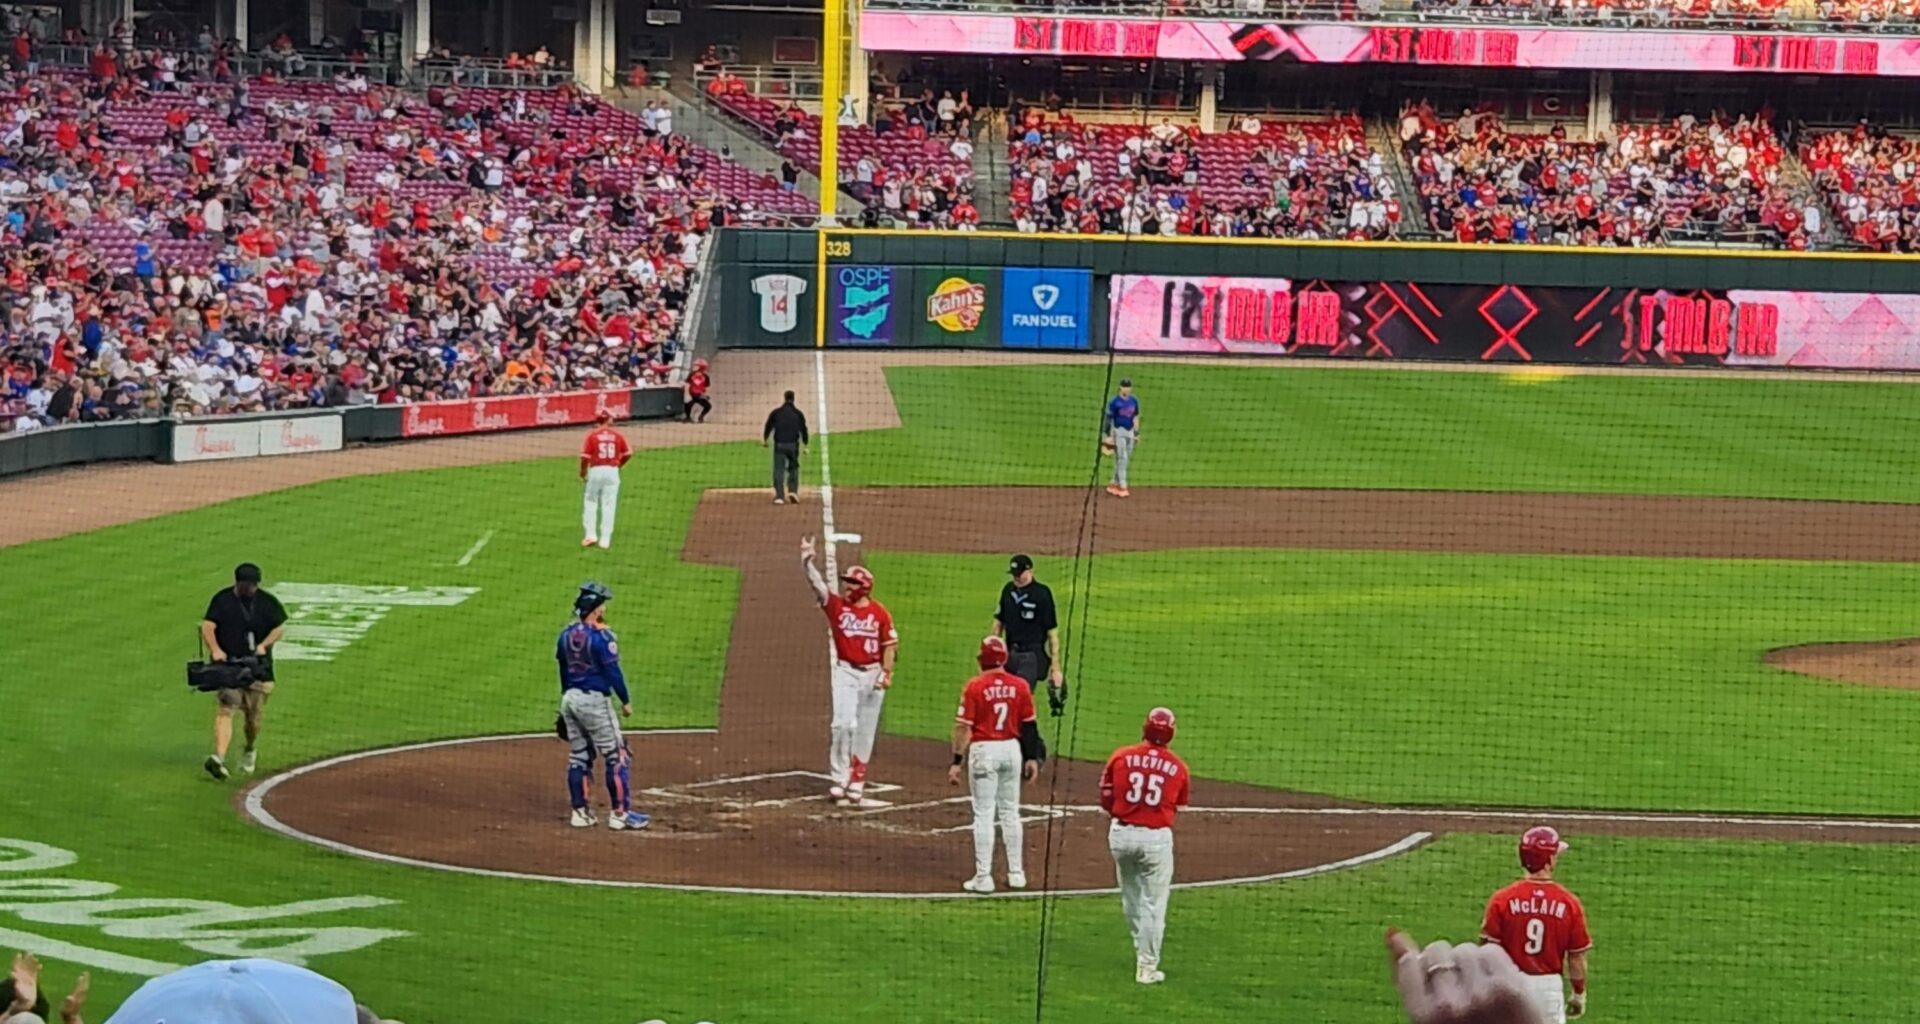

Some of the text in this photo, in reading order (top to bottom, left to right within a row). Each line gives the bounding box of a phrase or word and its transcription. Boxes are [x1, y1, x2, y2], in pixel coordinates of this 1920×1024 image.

[826, 241, 851, 256] 328
[839, 267, 891, 286] OSPF
[771, 295, 789, 315] 14
[931, 288, 984, 316] Kahn's
[1012, 314, 1077, 328] FANDUEL
[993, 702, 1009, 731] 7
[1125, 754, 1178, 777] TREVINO
[1125, 771, 1165, 807] 35
[1508, 897, 1567, 919] McLAIN
[1524, 918, 1545, 955] 9
